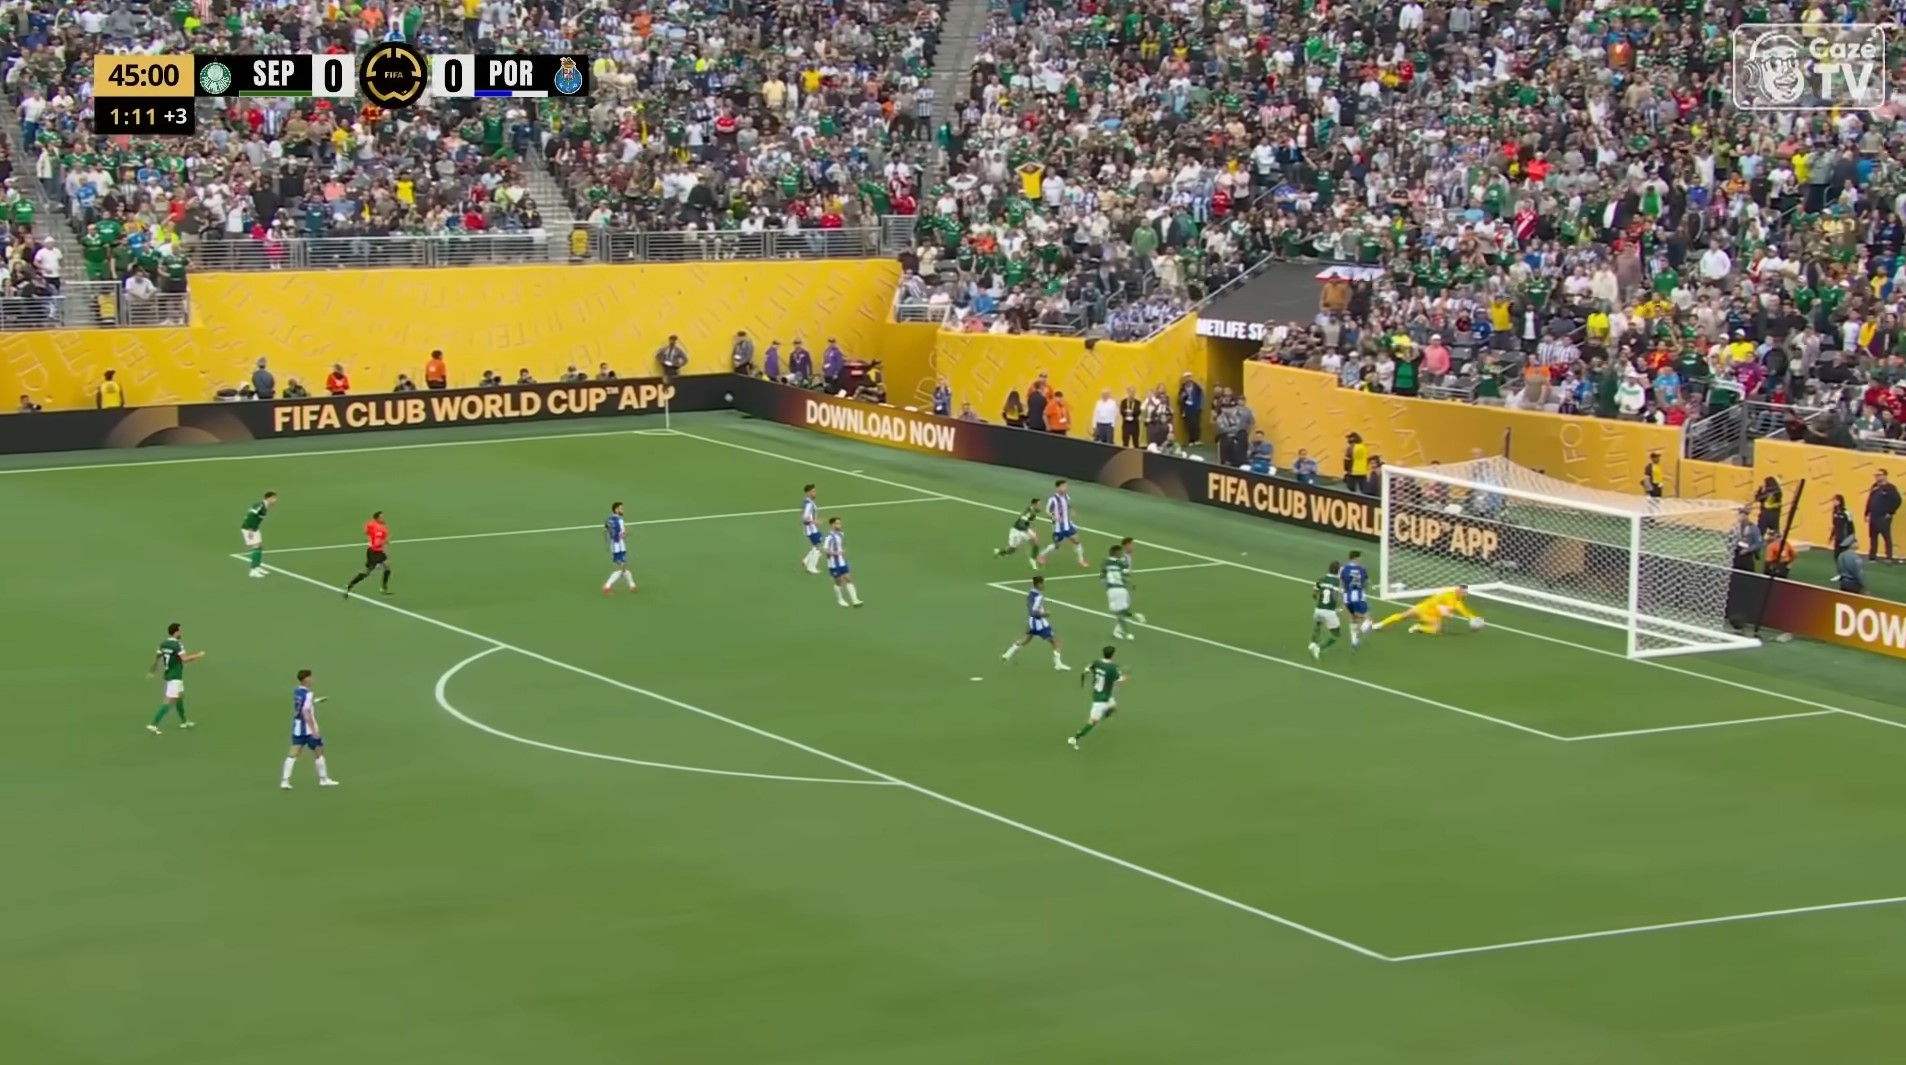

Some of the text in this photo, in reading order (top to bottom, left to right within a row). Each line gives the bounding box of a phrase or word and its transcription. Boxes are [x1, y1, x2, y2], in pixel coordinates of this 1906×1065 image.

[274, 404, 341, 432] FIFA
[345, 399, 426, 428] CLUB
[431, 391, 541, 422] WORLD
[618, 383, 676, 410] APP
[806, 399, 956, 452] DOWNLOAD NOW
[1208, 472, 1250, 508] FIFA
[1253, 482, 1308, 520] CLUB
[1450, 523, 1498, 559] APP
